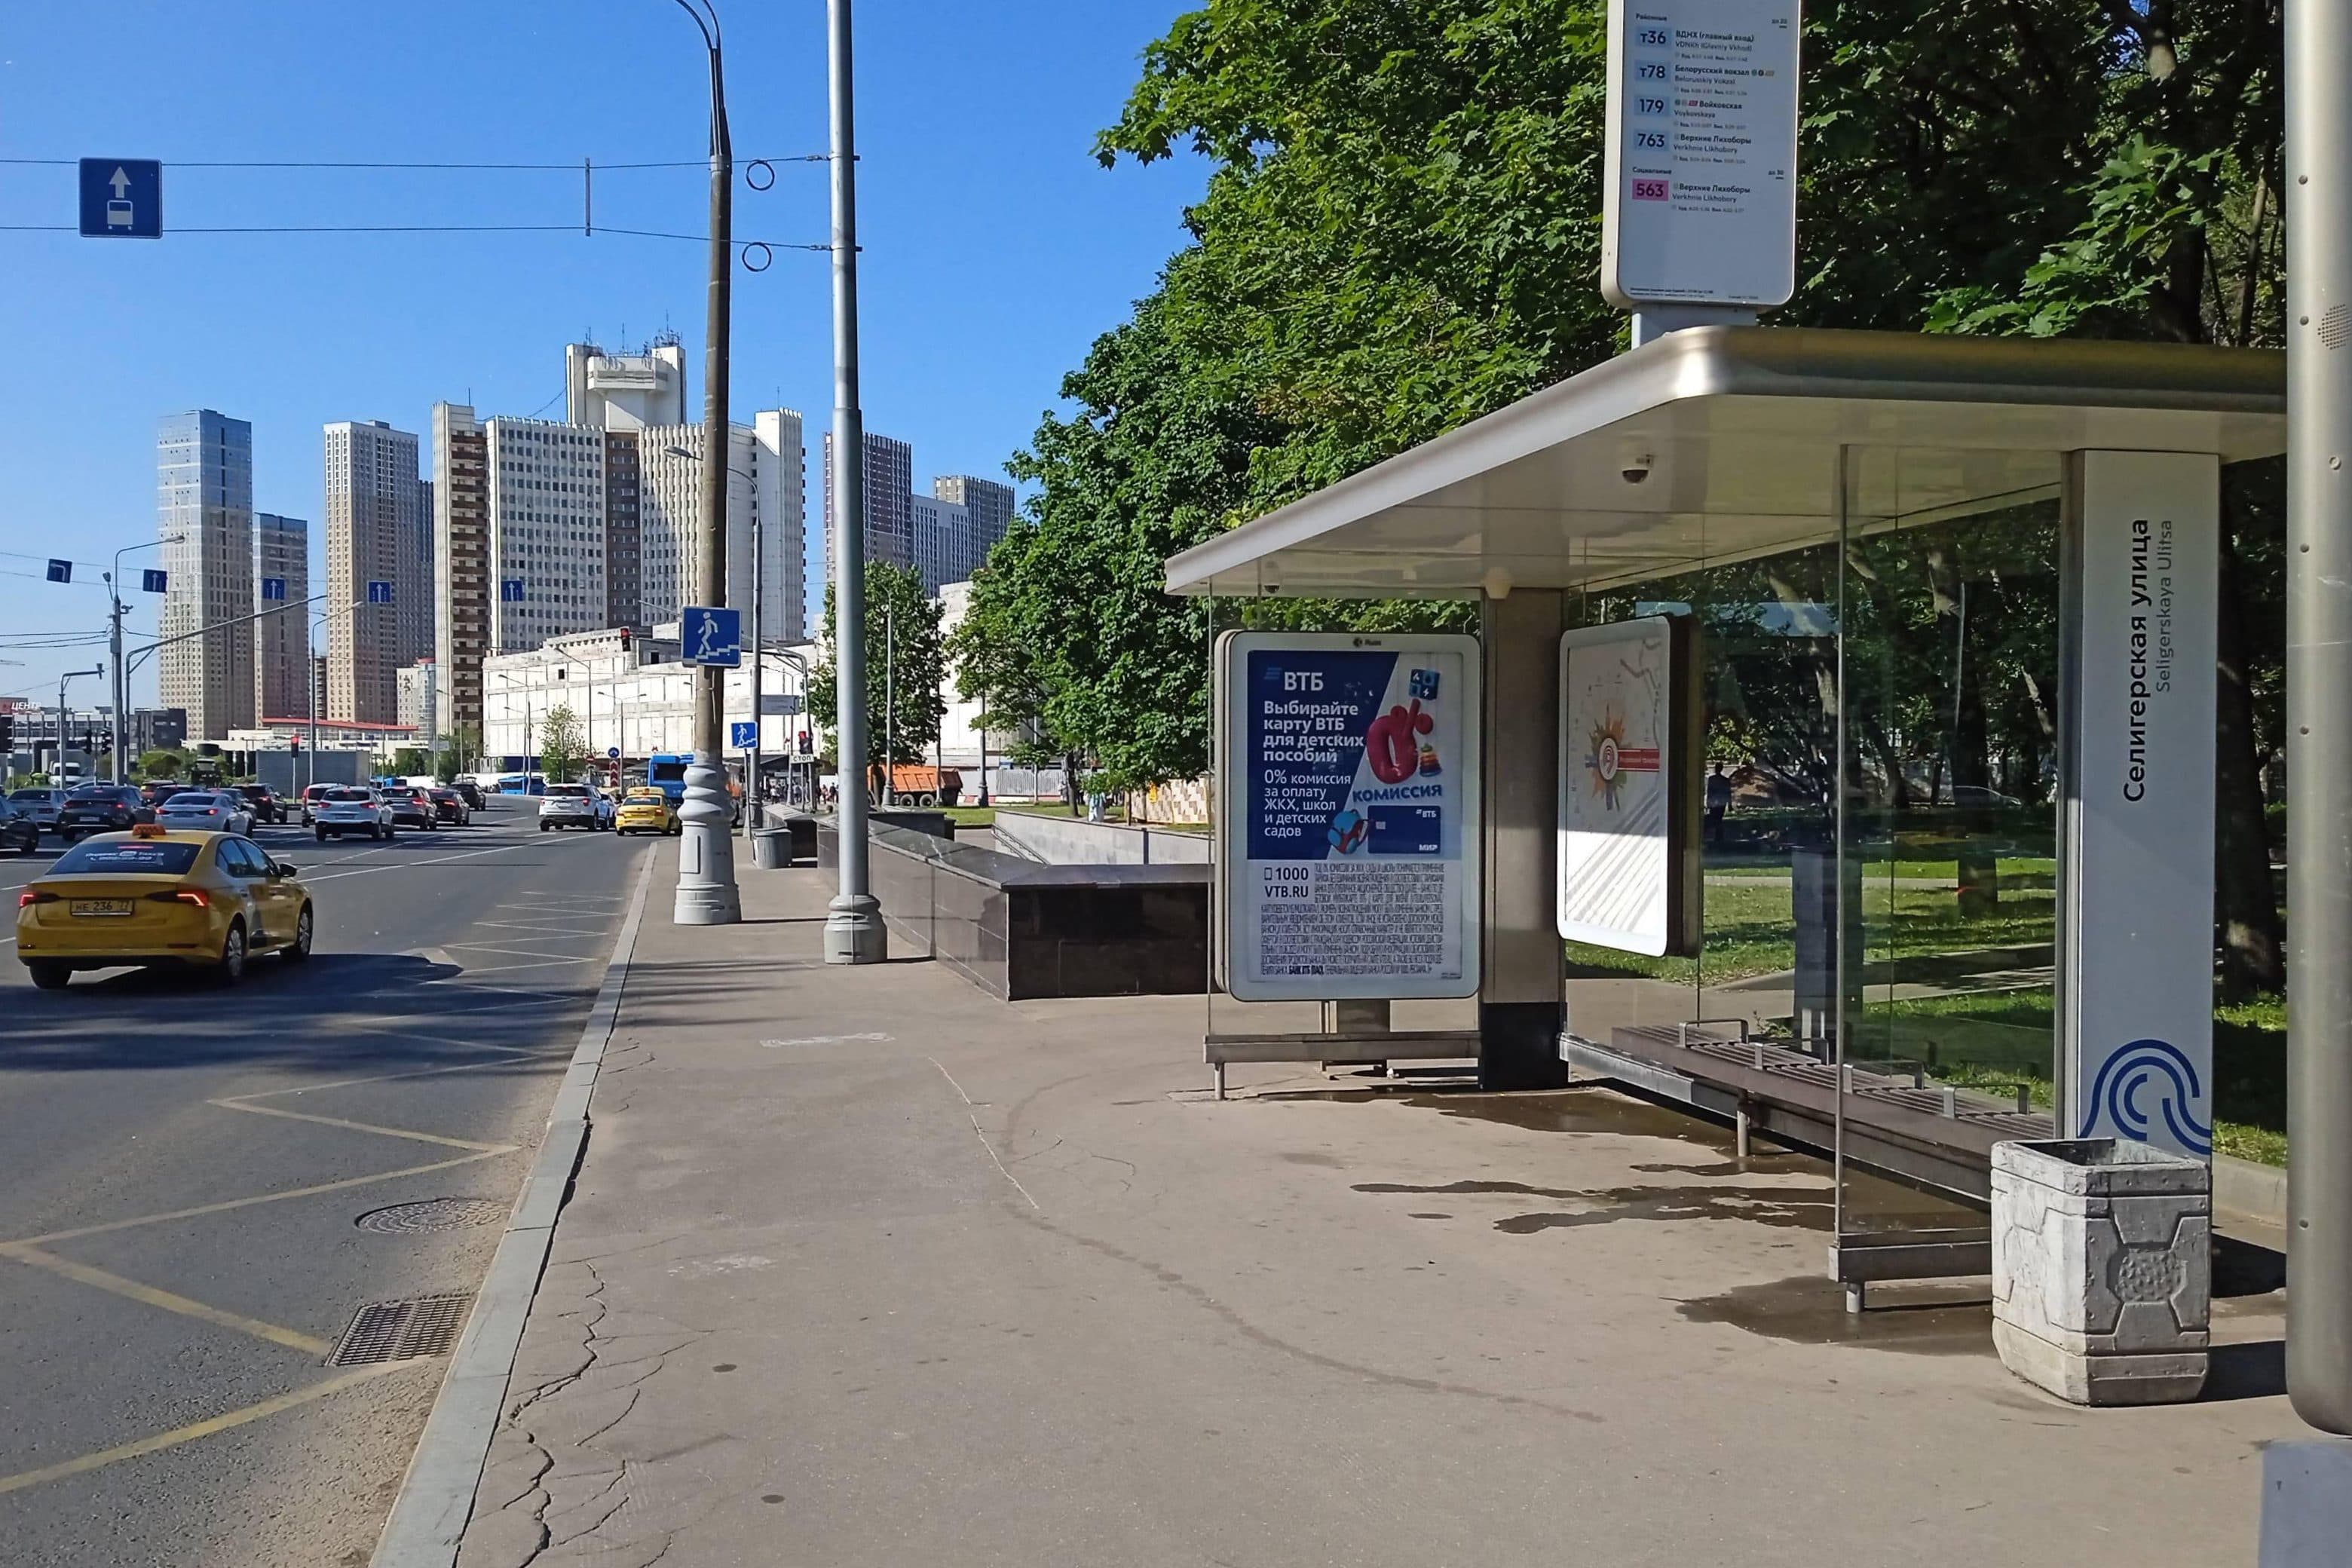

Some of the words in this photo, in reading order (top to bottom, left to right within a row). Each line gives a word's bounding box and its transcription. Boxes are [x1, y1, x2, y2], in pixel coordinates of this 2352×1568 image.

[1676, 30, 1698, 38] ВДНХ
[1675, 65, 1723, 75] Белорусский
[1640, 99, 1664, 113] 179
[1699, 100, 1743, 109] Войковская
[1637, 133, 1665, 148] 763
[1680, 134, 1711, 143] Верхние
[1713, 135, 1751, 145] Лихоборы
[1636, 183, 1664, 198] 563
[1680, 183, 1710, 192] Верхние
[1712, 185, 1750, 194] Лихоборы
[2158, 520, 2173, 571] Ulitsa
[2130, 519, 2152, 606] улица
[2156, 577, 2174, 692] Seligerskaya
[1284, 672, 1324, 691] ВТБ
[1264, 701, 1358, 718] Выбирайте
[2123, 616, 2151, 801] Селигерская
[1264, 718, 1312, 733] карту
[1315, 718, 1345, 730] ВТБ
[1263, 734, 1294, 748] для
[1297, 734, 1364, 749] детских
[1264, 749, 1337, 763] пособий
[1264, 770, 1287, 785] 0%
[1291, 773, 1351, 785] комиссия
[1264, 789, 1279, 798] за
[1282, 788, 1327, 800] оплату
[1264, 799, 1300, 811] ЖКХ,
[1303, 801, 1336, 810] школ
[1264, 815, 1273, 823] и
[1276, 814, 1327, 825] детских
[1264, 827, 1302, 838] садов
[1276, 867, 1309, 880] 1000
[1264, 886, 1309, 898] VTB.RU
[93, 902, 112, 911] 236
